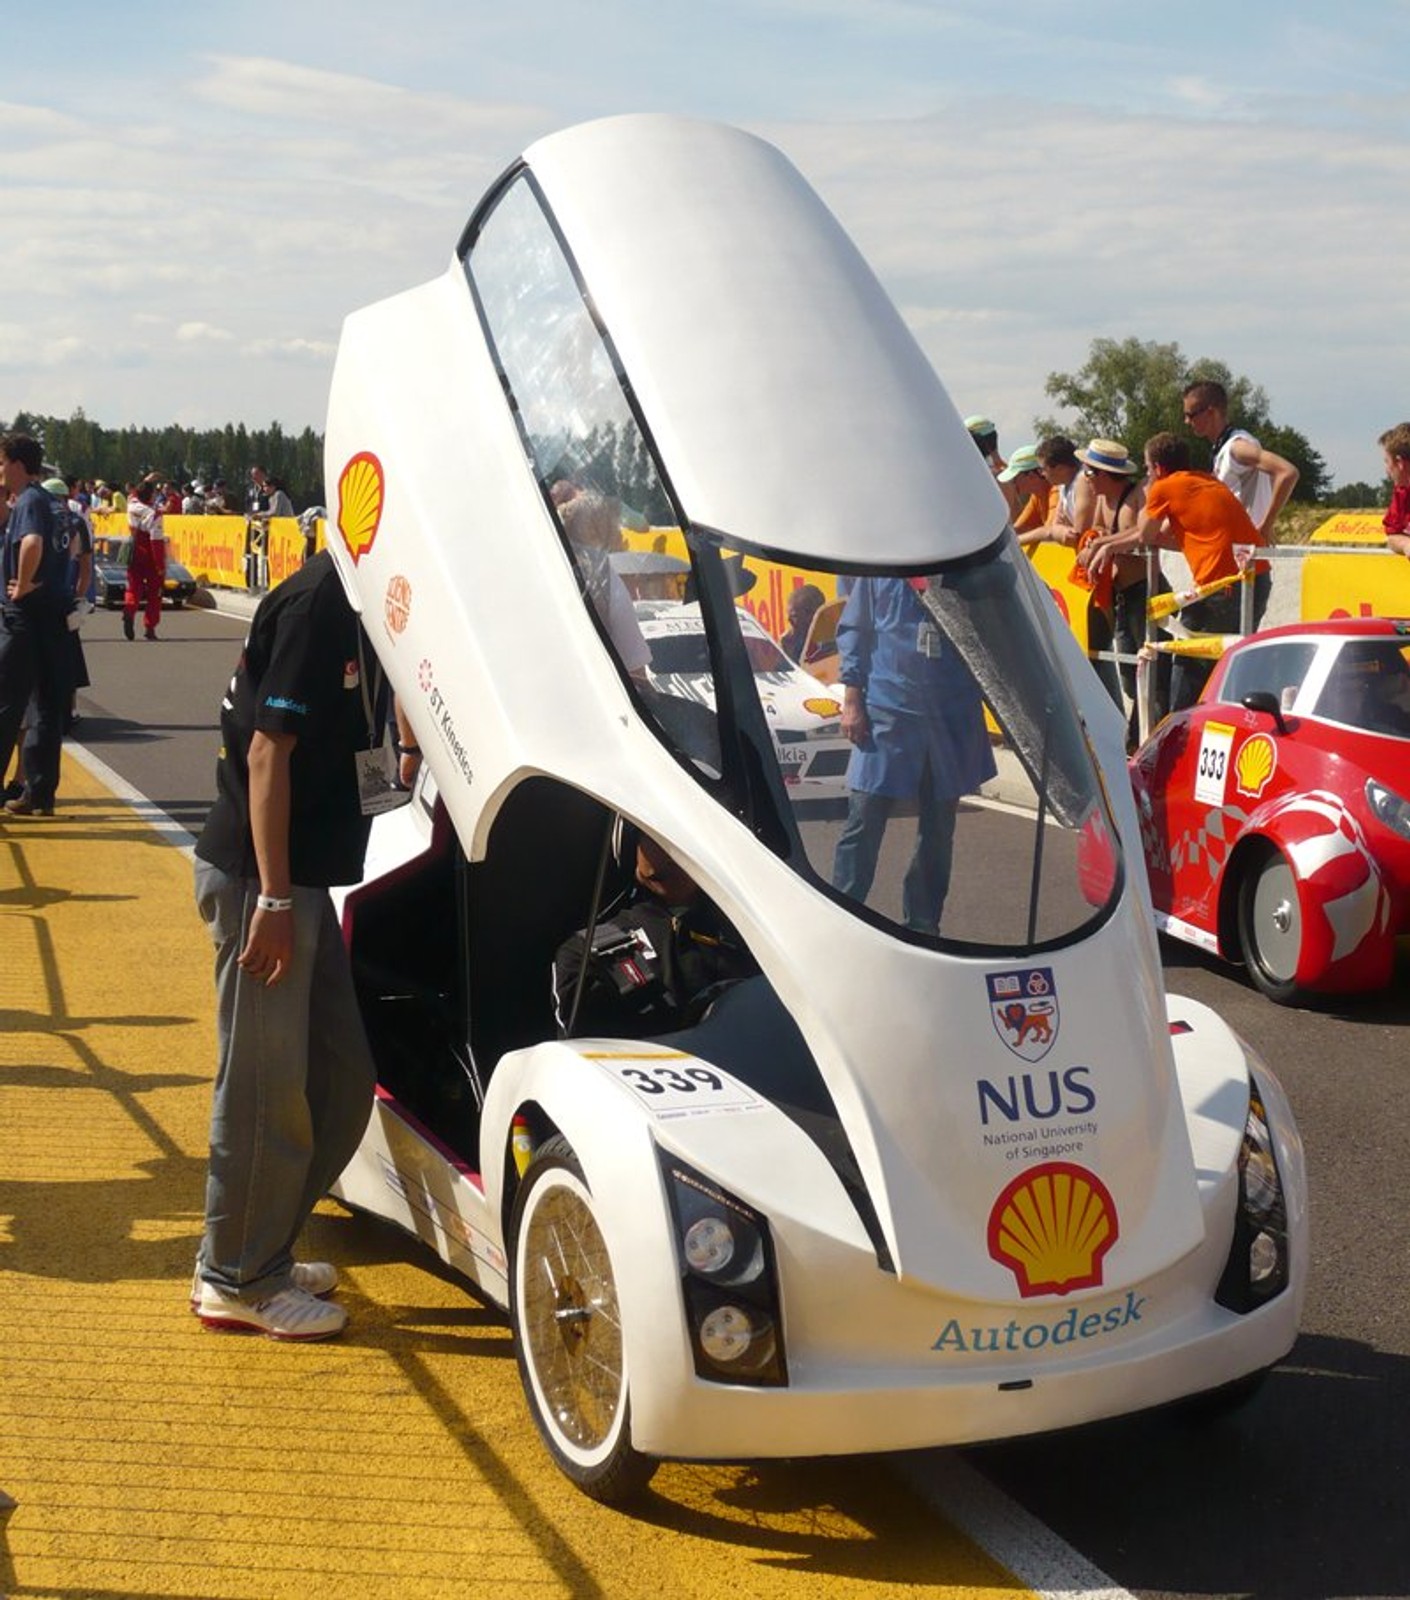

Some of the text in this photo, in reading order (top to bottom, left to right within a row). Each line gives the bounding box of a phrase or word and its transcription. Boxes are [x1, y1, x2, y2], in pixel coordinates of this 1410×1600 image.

[430, 687, 445, 716] ST
[441, 710, 474, 785] Kinetics
[1200, 747, 1225, 781] 333
[621, 1067, 723, 1095] 339
[977, 1066, 1096, 1125] NUS
[983, 1122, 1099, 1146] National University
[1005, 1141, 1084, 1160] of Singapore
[931, 1291, 1145, 1352] Autodesk
